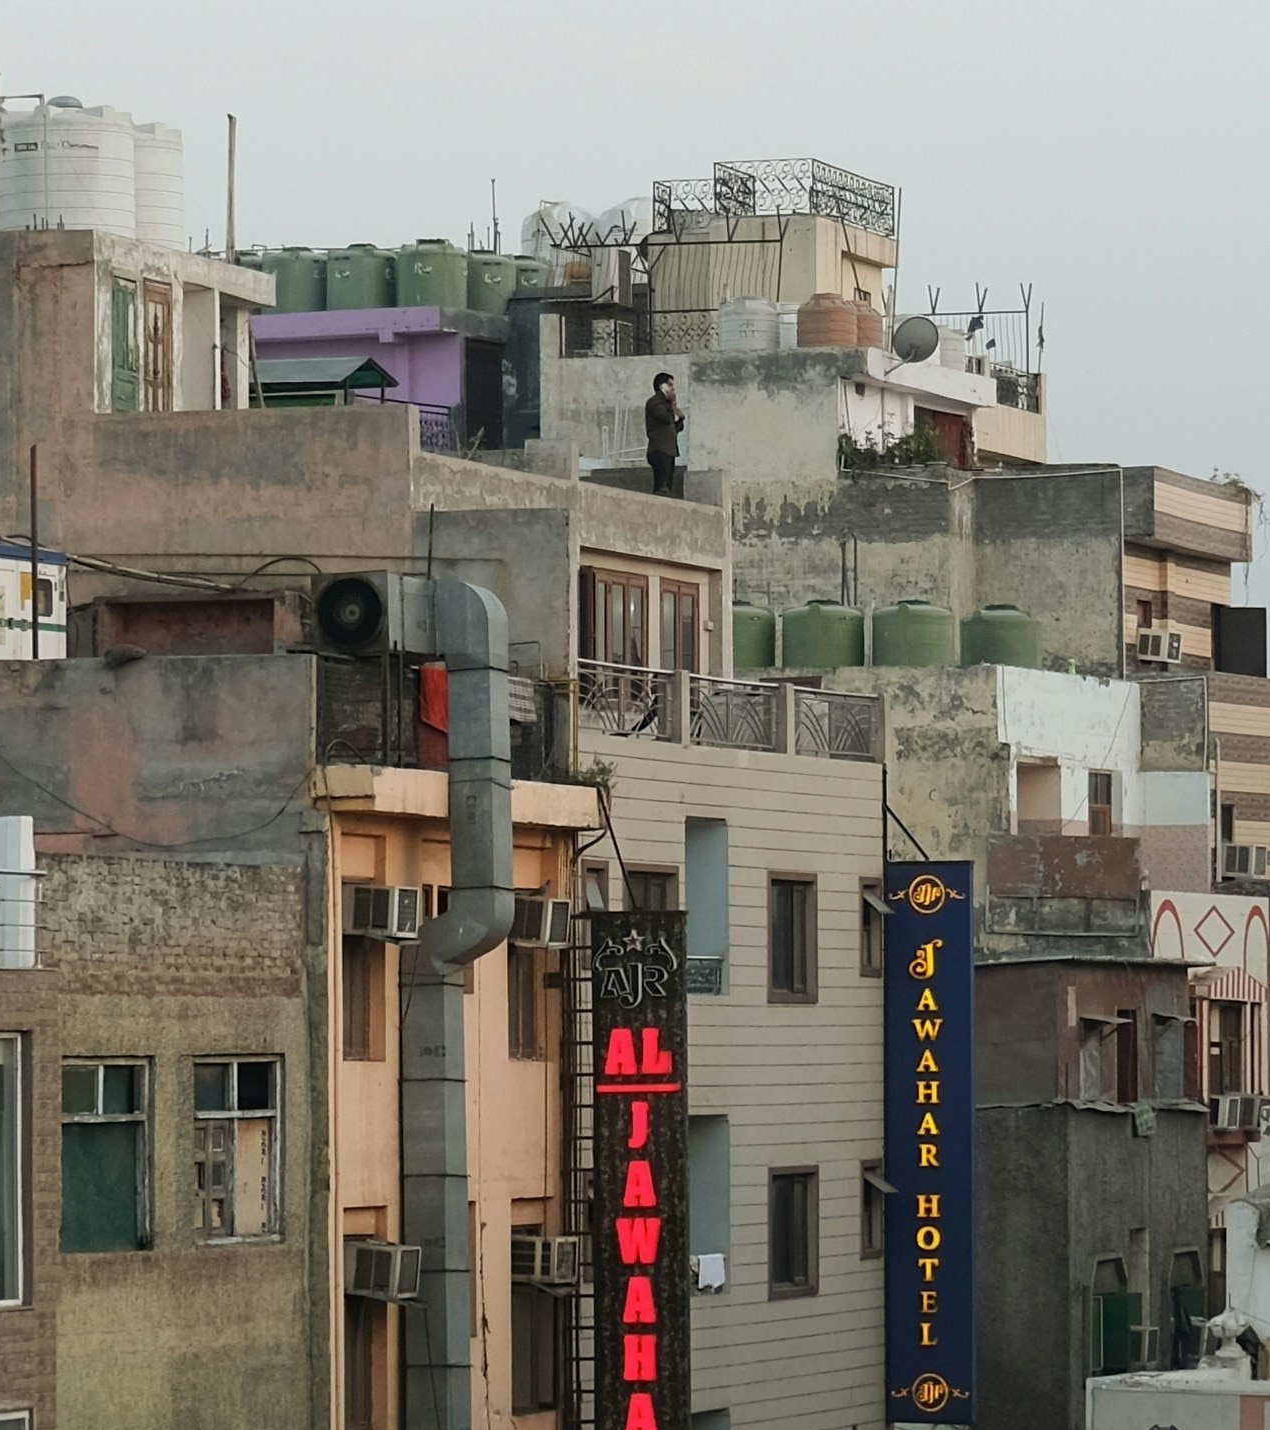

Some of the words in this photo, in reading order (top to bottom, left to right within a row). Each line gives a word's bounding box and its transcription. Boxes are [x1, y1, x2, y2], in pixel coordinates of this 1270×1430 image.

[603, 1028, 673, 1075] AL
[908, 940, 943, 1167] JAWAHAR
[915, 1194, 942, 1347] HOTEL
